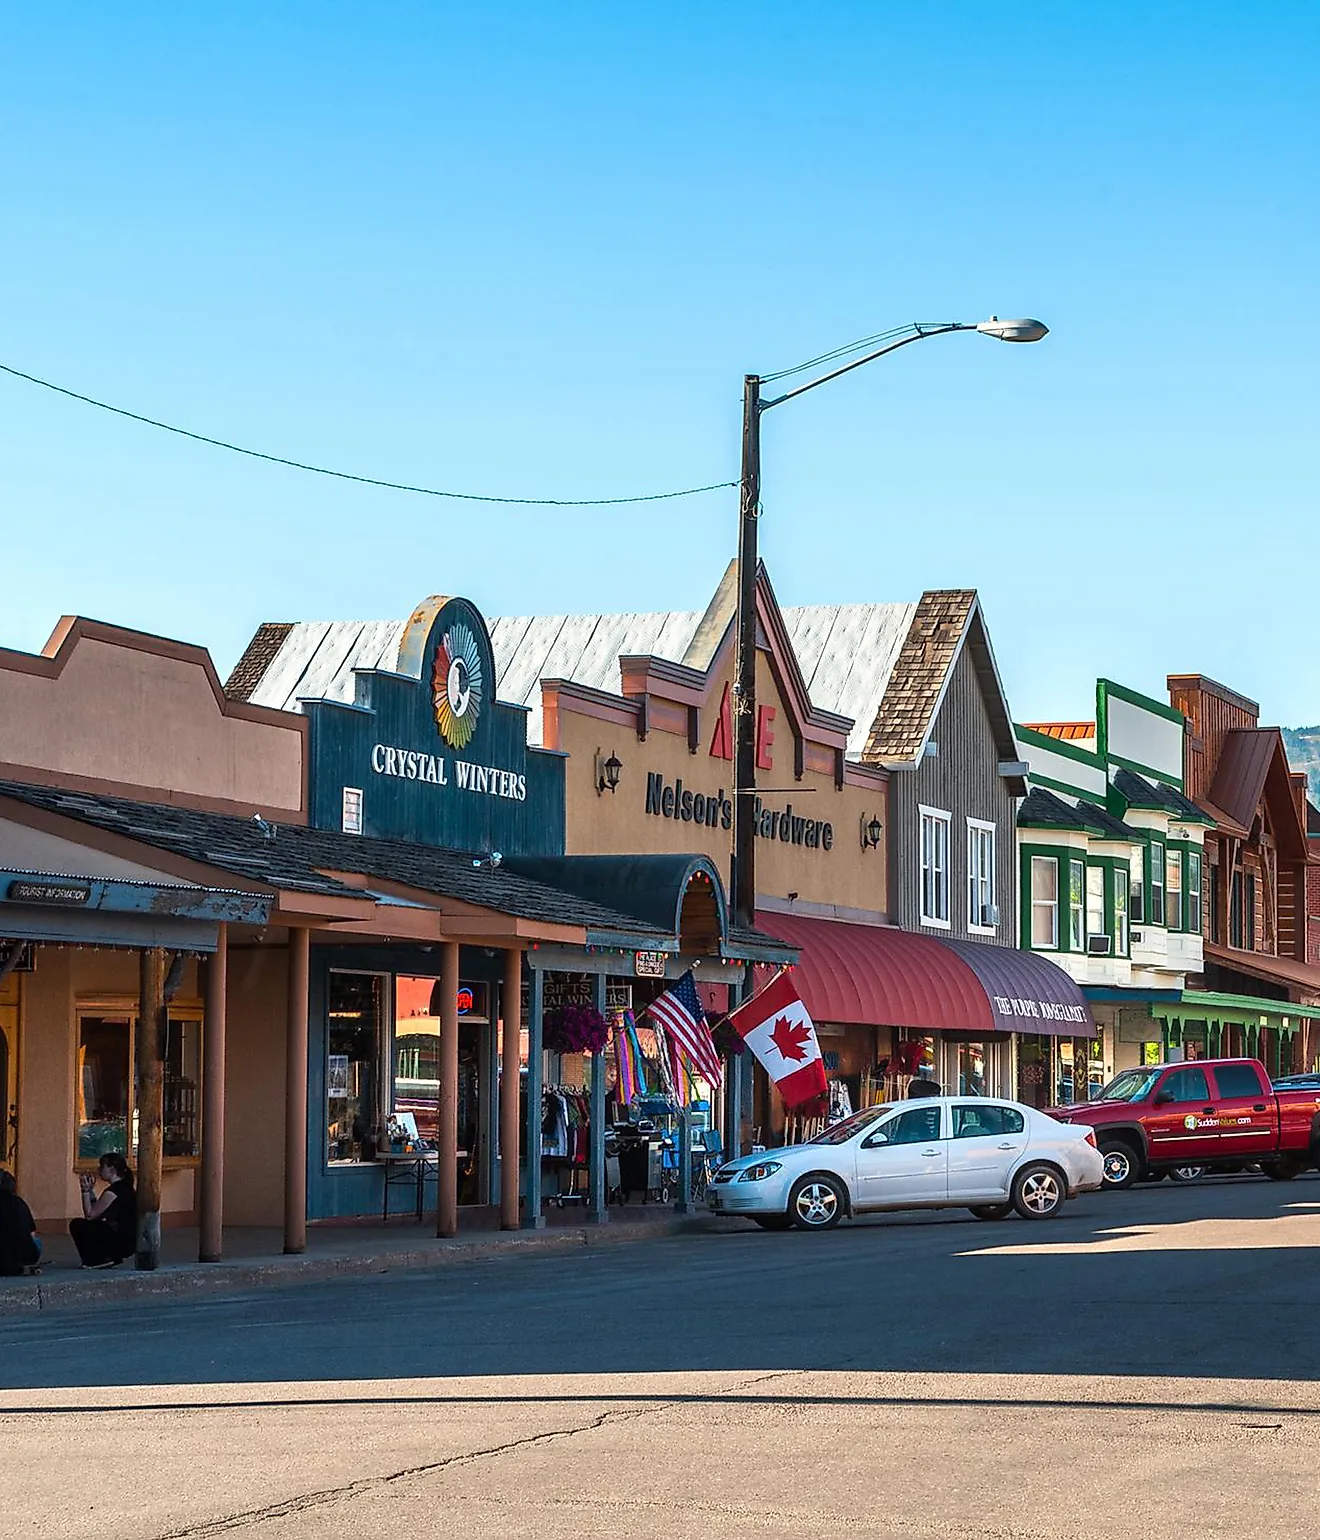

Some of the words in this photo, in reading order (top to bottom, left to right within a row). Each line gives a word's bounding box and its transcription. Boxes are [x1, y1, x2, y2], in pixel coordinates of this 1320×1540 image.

[709, 681, 776, 770] AE
[371, 743, 448, 786] CRYSTAL
[454, 760, 526, 802] WINTERS
[645, 771, 733, 830] Nelson's
[544, 983, 590, 995] GIFTS
